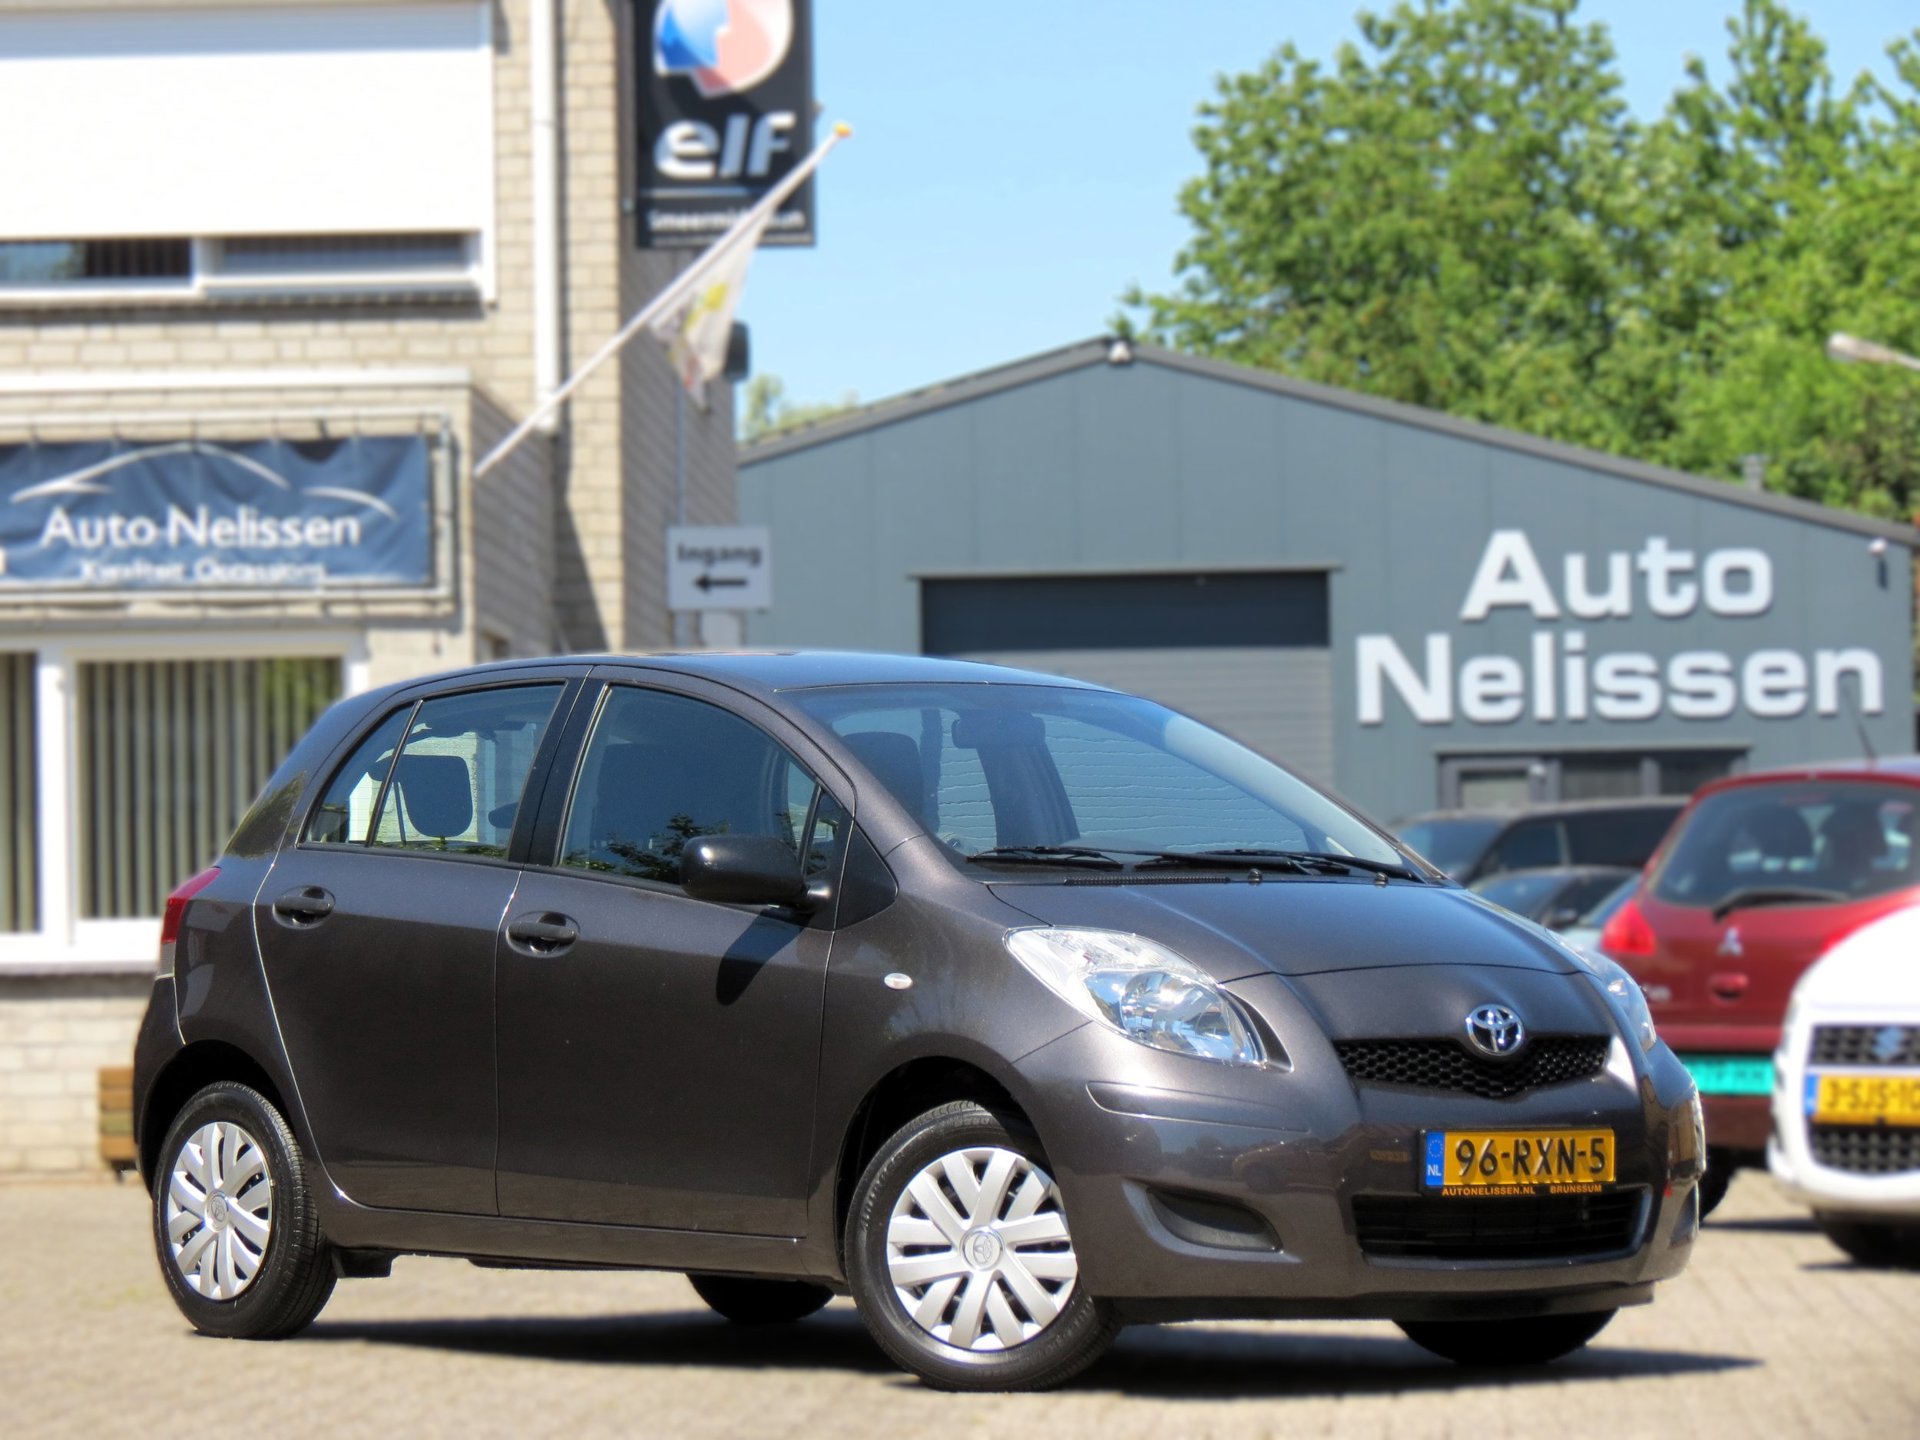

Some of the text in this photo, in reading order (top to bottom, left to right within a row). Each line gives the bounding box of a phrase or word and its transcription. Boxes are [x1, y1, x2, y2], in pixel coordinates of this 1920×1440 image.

[654, 111, 796, 179] elf
[40, 505, 361, 548] Auto Nelissen
[1460, 530, 1773, 620] Auto
[1356, 631, 1883, 725] Nelissen
[1427, 1137, 1605, 1177] NL 96-RXN-5
[1442, 1183, 1603, 1196] AUTONELISSEN.NL BRUNSSUM
